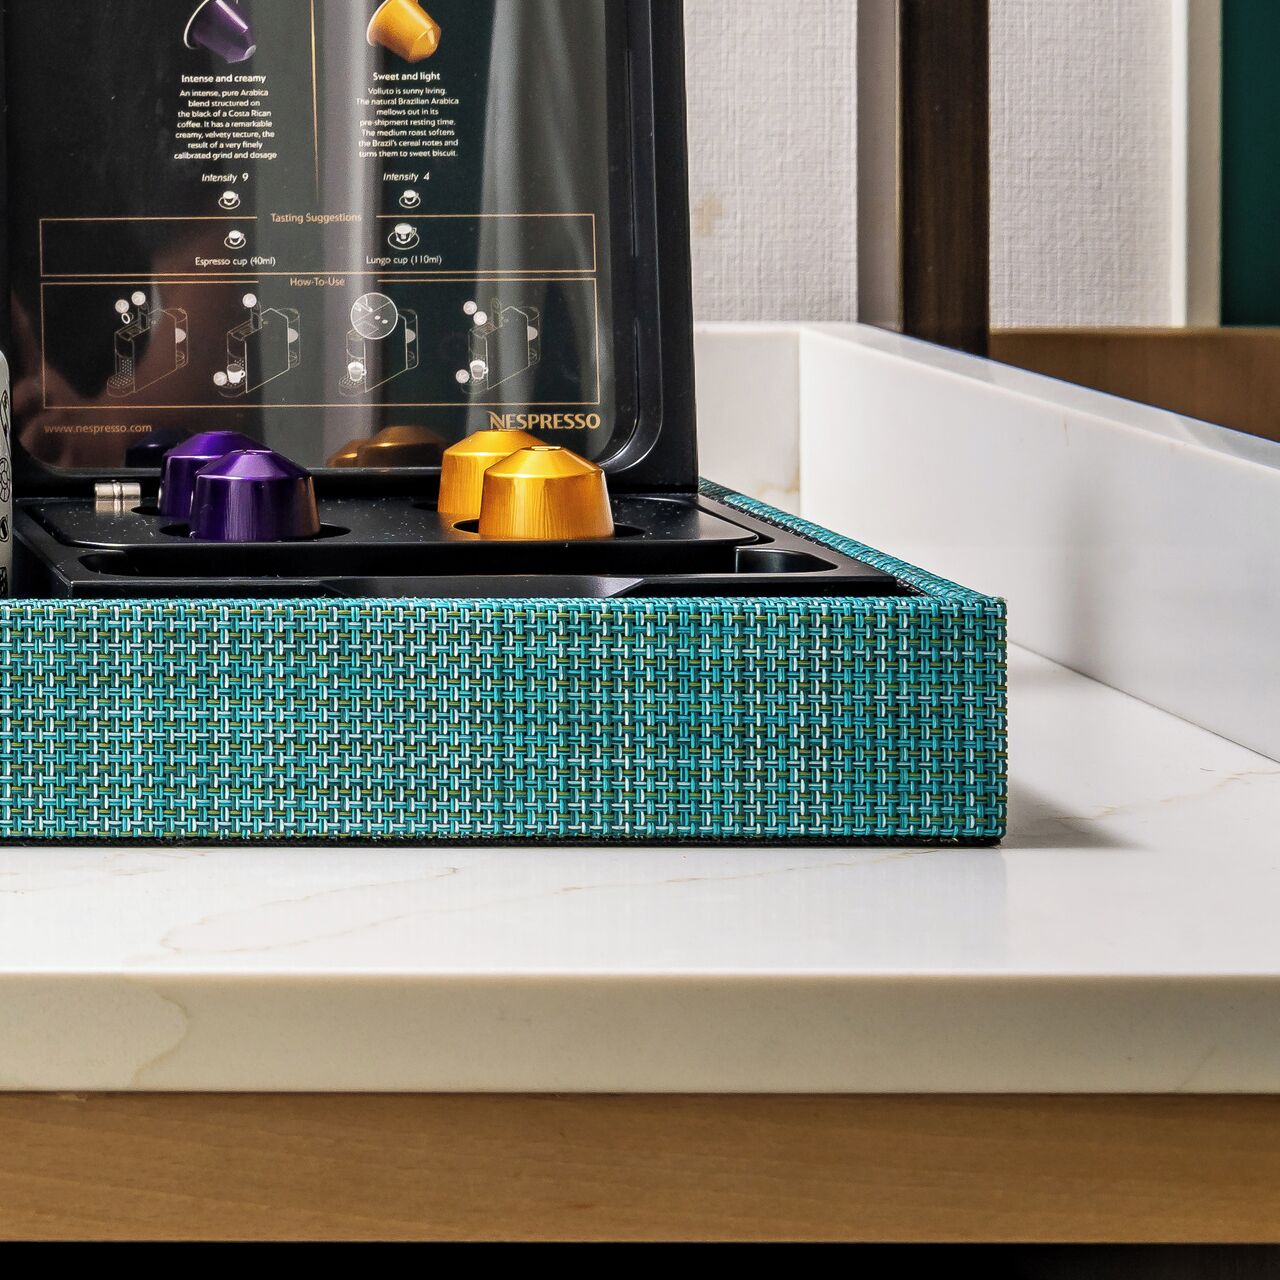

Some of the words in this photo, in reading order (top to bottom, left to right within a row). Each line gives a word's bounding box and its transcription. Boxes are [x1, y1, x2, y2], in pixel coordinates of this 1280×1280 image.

[216, 74, 232, 82] and
[234, 75, 266, 84] creamy
[373, 72, 399, 80] Sweet
[402, 72, 418, 80] and
[420, 72, 440, 82] light
[410, 119, 435, 127] resting
[175, 132, 203, 140] creamy,
[205, 132, 231, 140] velvety
[243, 141, 263, 149] finely
[213, 151, 232, 160] grind
[250, 152, 277, 160] dosage
[242, 173, 248, 181] 9
[271, 213, 304, 224] Tasting
[306, 213, 362, 224] Suggestions
[195, 257, 230, 267] Espresso
[233, 258, 247, 266] cup
[250, 256, 275, 266] (40ml)
[366, 256, 390, 266] Lungo
[411, 255, 442, 265] (110ml)
[290, 278, 345, 286] How-To-Use
[487, 411, 601, 429] NESPRESSO
[44, 424, 152, 434] www.nespresso.com
